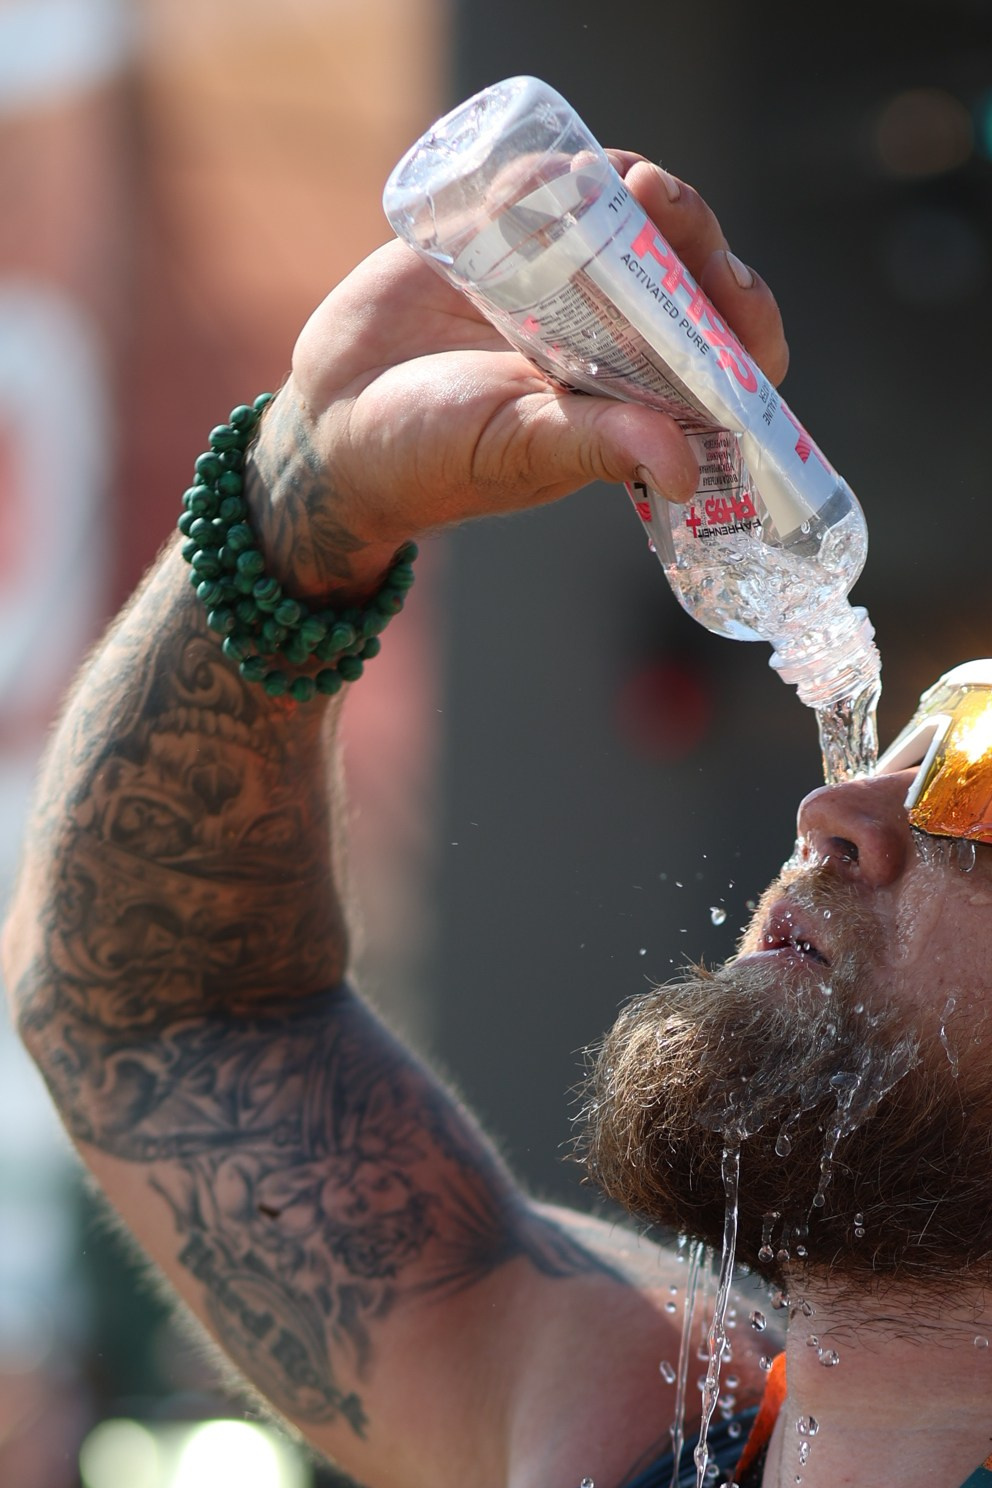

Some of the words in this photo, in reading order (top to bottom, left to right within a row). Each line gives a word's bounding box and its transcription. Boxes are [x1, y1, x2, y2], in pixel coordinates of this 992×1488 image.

[620, 253, 680, 320] ACTIVATED
[678, 318, 710, 356] PURE
[698, 518, 762, 538] FAHRENHEIT
